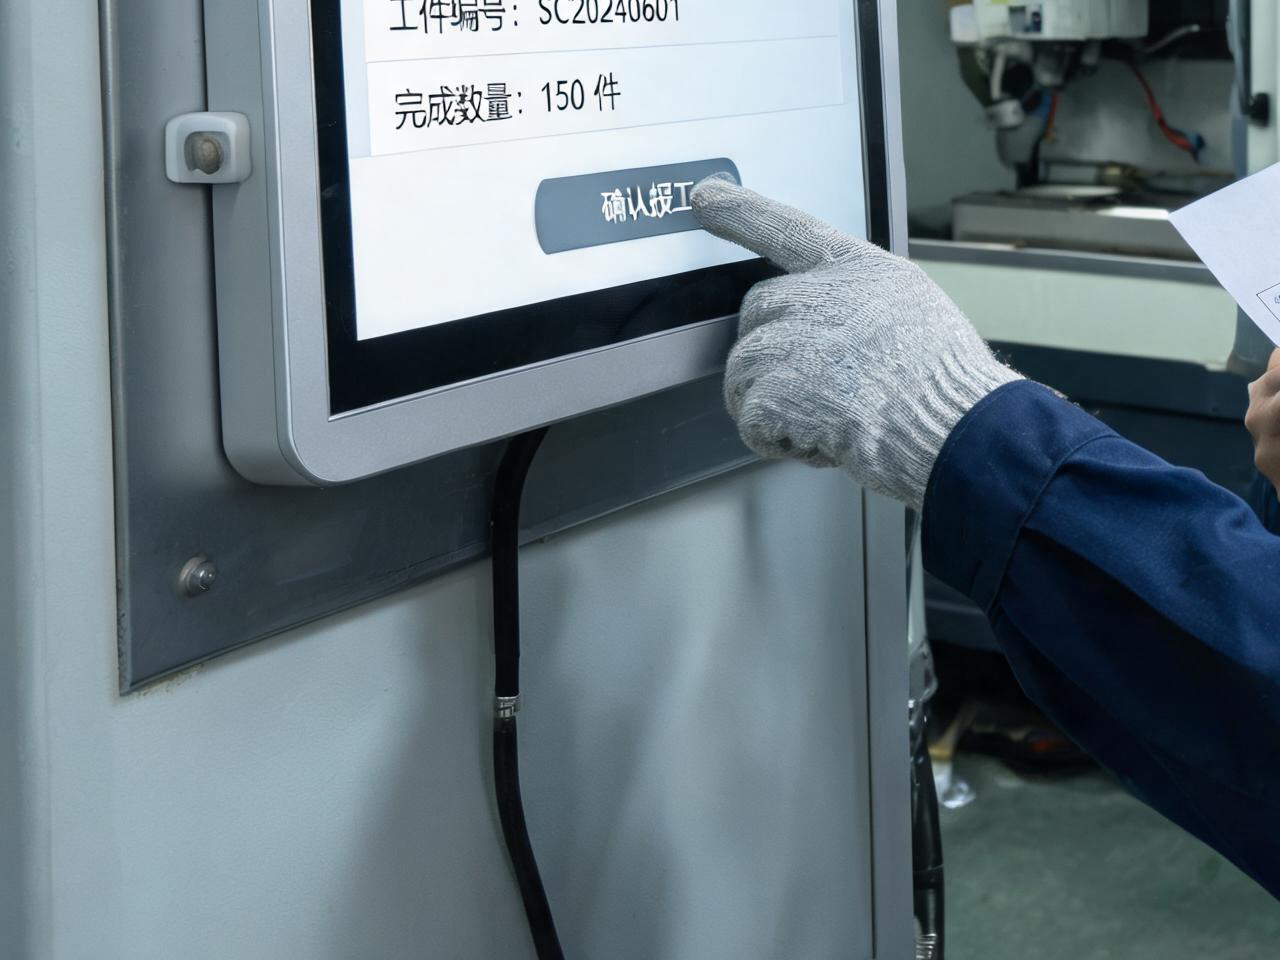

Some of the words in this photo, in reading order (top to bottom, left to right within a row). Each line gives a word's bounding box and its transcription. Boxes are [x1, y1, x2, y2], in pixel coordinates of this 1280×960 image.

[541, 78, 585, 112] 150
[594, 72, 621, 111] 件
[601, 181, 694, 223] 确认报工
